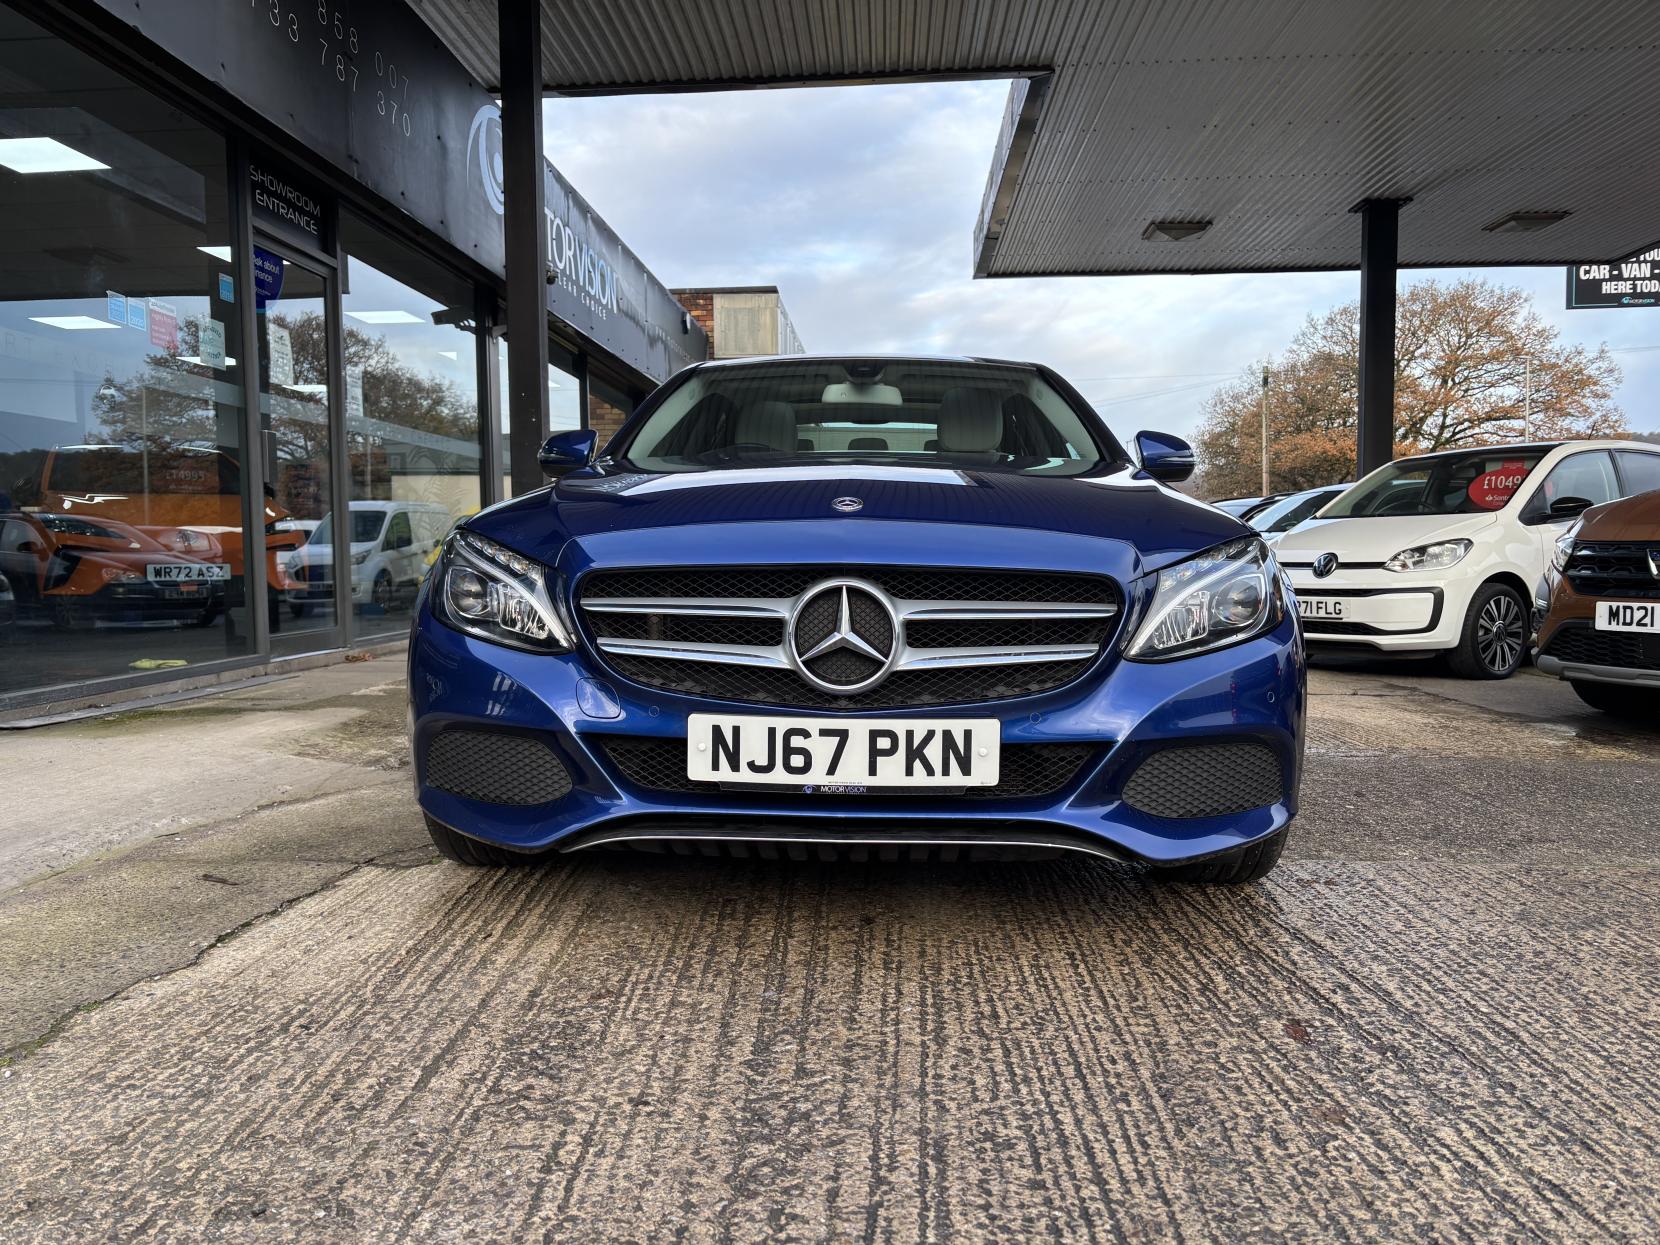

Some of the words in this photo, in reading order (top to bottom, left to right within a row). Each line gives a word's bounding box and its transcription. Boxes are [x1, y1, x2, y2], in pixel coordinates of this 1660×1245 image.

[319, 38, 359, 93] 787
[377, 90, 411, 137] 370
[375, 51, 409, 101] 007
[250, 165, 321, 217] SHOWROOM
[255, 190, 318, 235] ENTRANCE
[1579, 264, 1610, 280] CAR
[1620, 262, 1651, 278] VAN
[1602, 280, 1634, 294] HERE
[1634, 280, 1660, 293] TOD
[555, 271, 577, 297] LEAR
[581, 292, 606, 320] CHOICE
[1483, 475, 1525, 489] £1049
[153, 566, 192, 578] WR72
[197, 566, 225, 578] ASZ
[1316, 601, 1342, 615] FLG
[1608, 604, 1655, 628] MD21
[711, 724, 850, 776] NJ67
[868, 728, 972, 777] PKN
